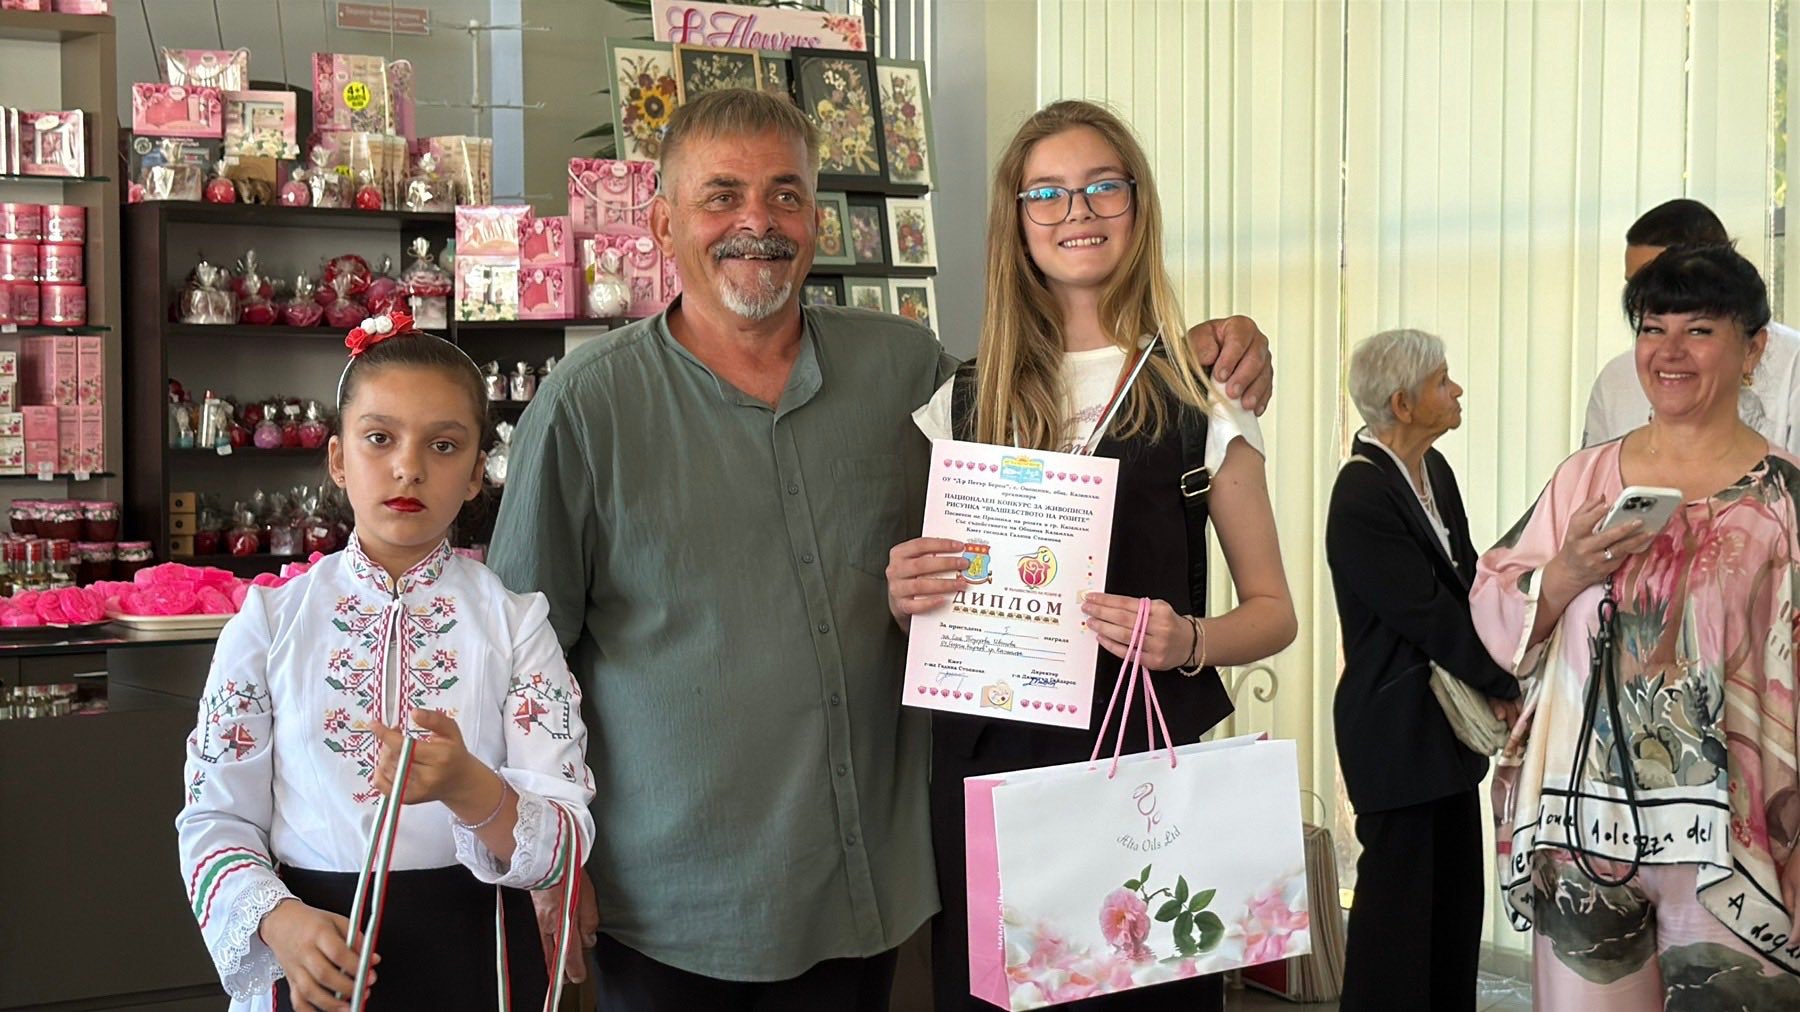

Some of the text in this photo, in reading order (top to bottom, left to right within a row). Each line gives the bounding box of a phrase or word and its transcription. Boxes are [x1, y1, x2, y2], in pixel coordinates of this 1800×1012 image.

[944, 493, 995, 505] НАЦИОНАЛЕН
[997, 499, 1032, 509] КОНКУРС
[1044, 505, 1093, 516] ЖИВОПИСНА
[946, 501, 980, 510] РИСУНКА
[952, 590, 1062, 615] ДИПЛОМ
[1141, 837, 1162, 852] Oils
[1164, 825, 1181, 847] Ltd
